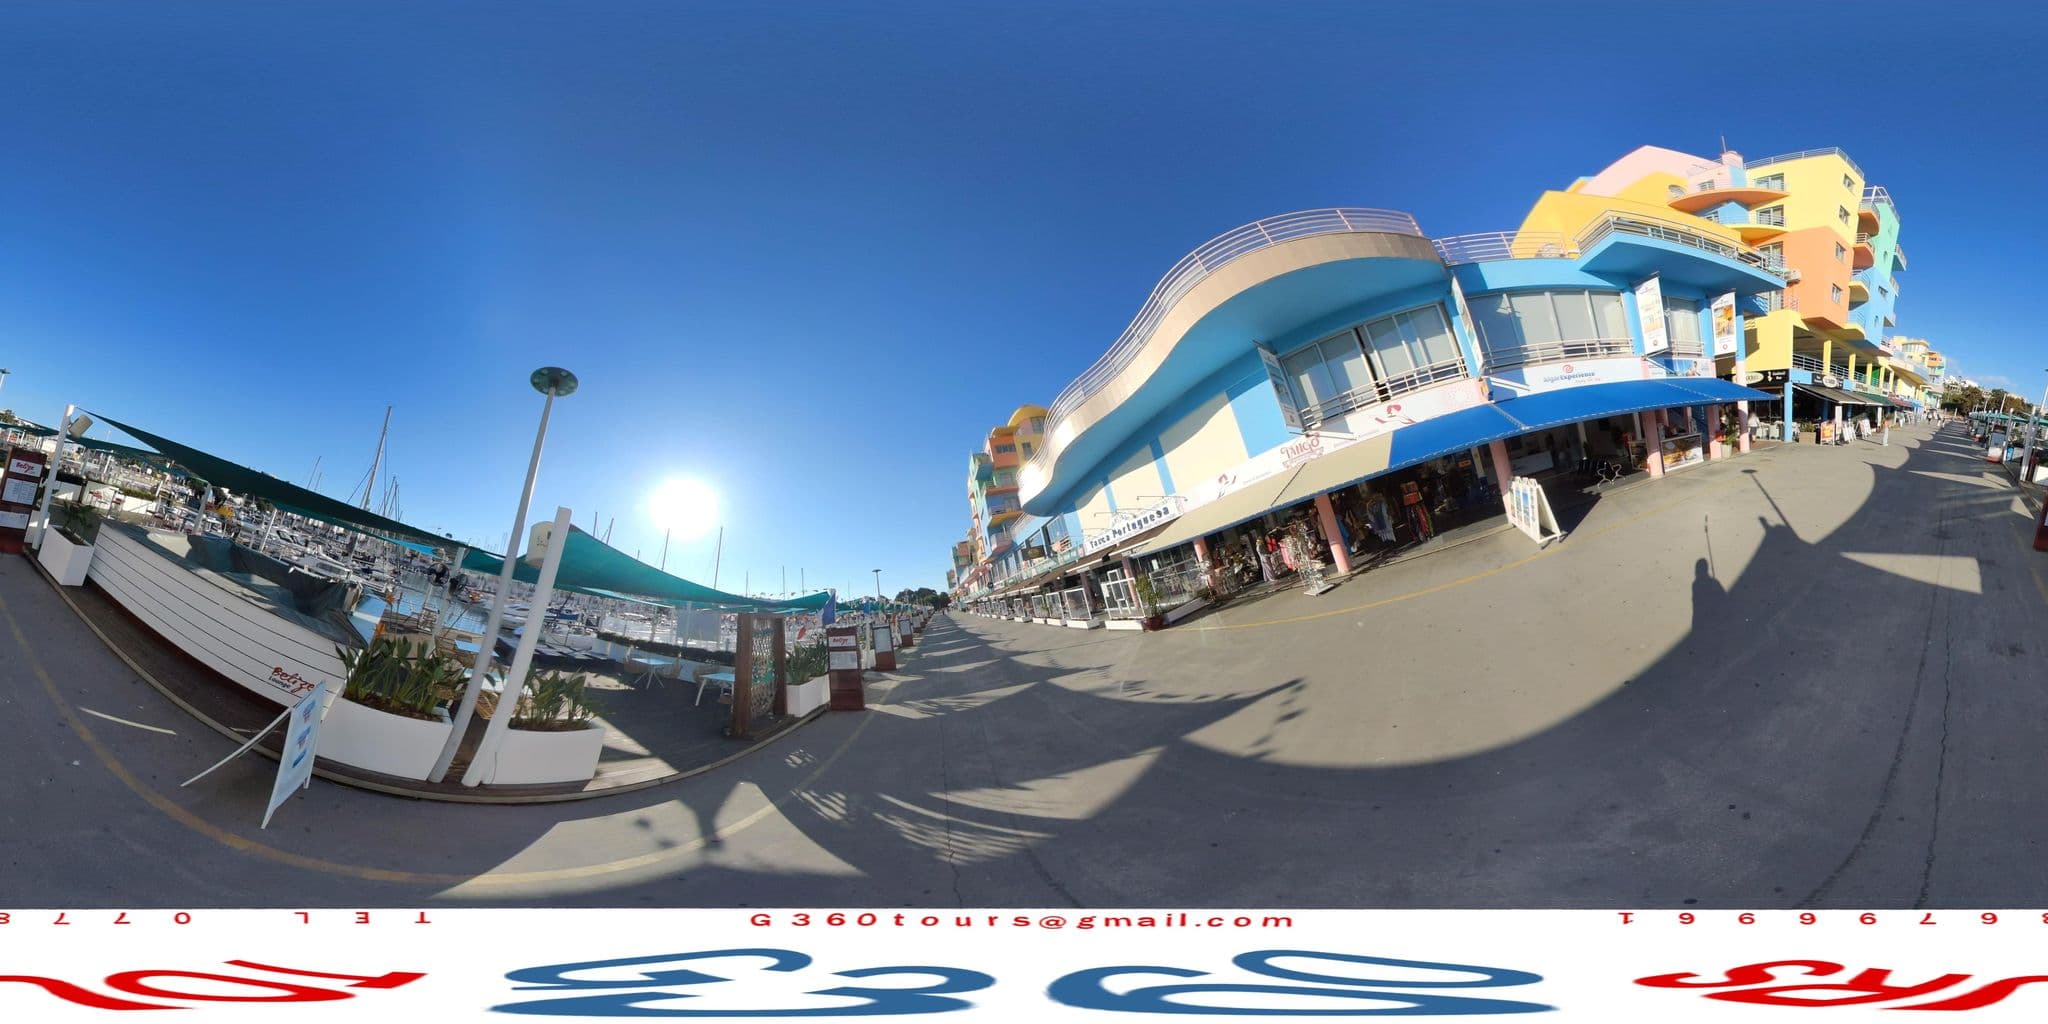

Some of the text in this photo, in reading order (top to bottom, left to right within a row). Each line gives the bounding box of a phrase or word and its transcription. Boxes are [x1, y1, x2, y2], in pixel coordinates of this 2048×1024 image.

[1090, 506, 1170, 549] Tasca Portuguesa
[269, 675, 291, 688] Lounge
[271, 667, 315, 693] Belize
